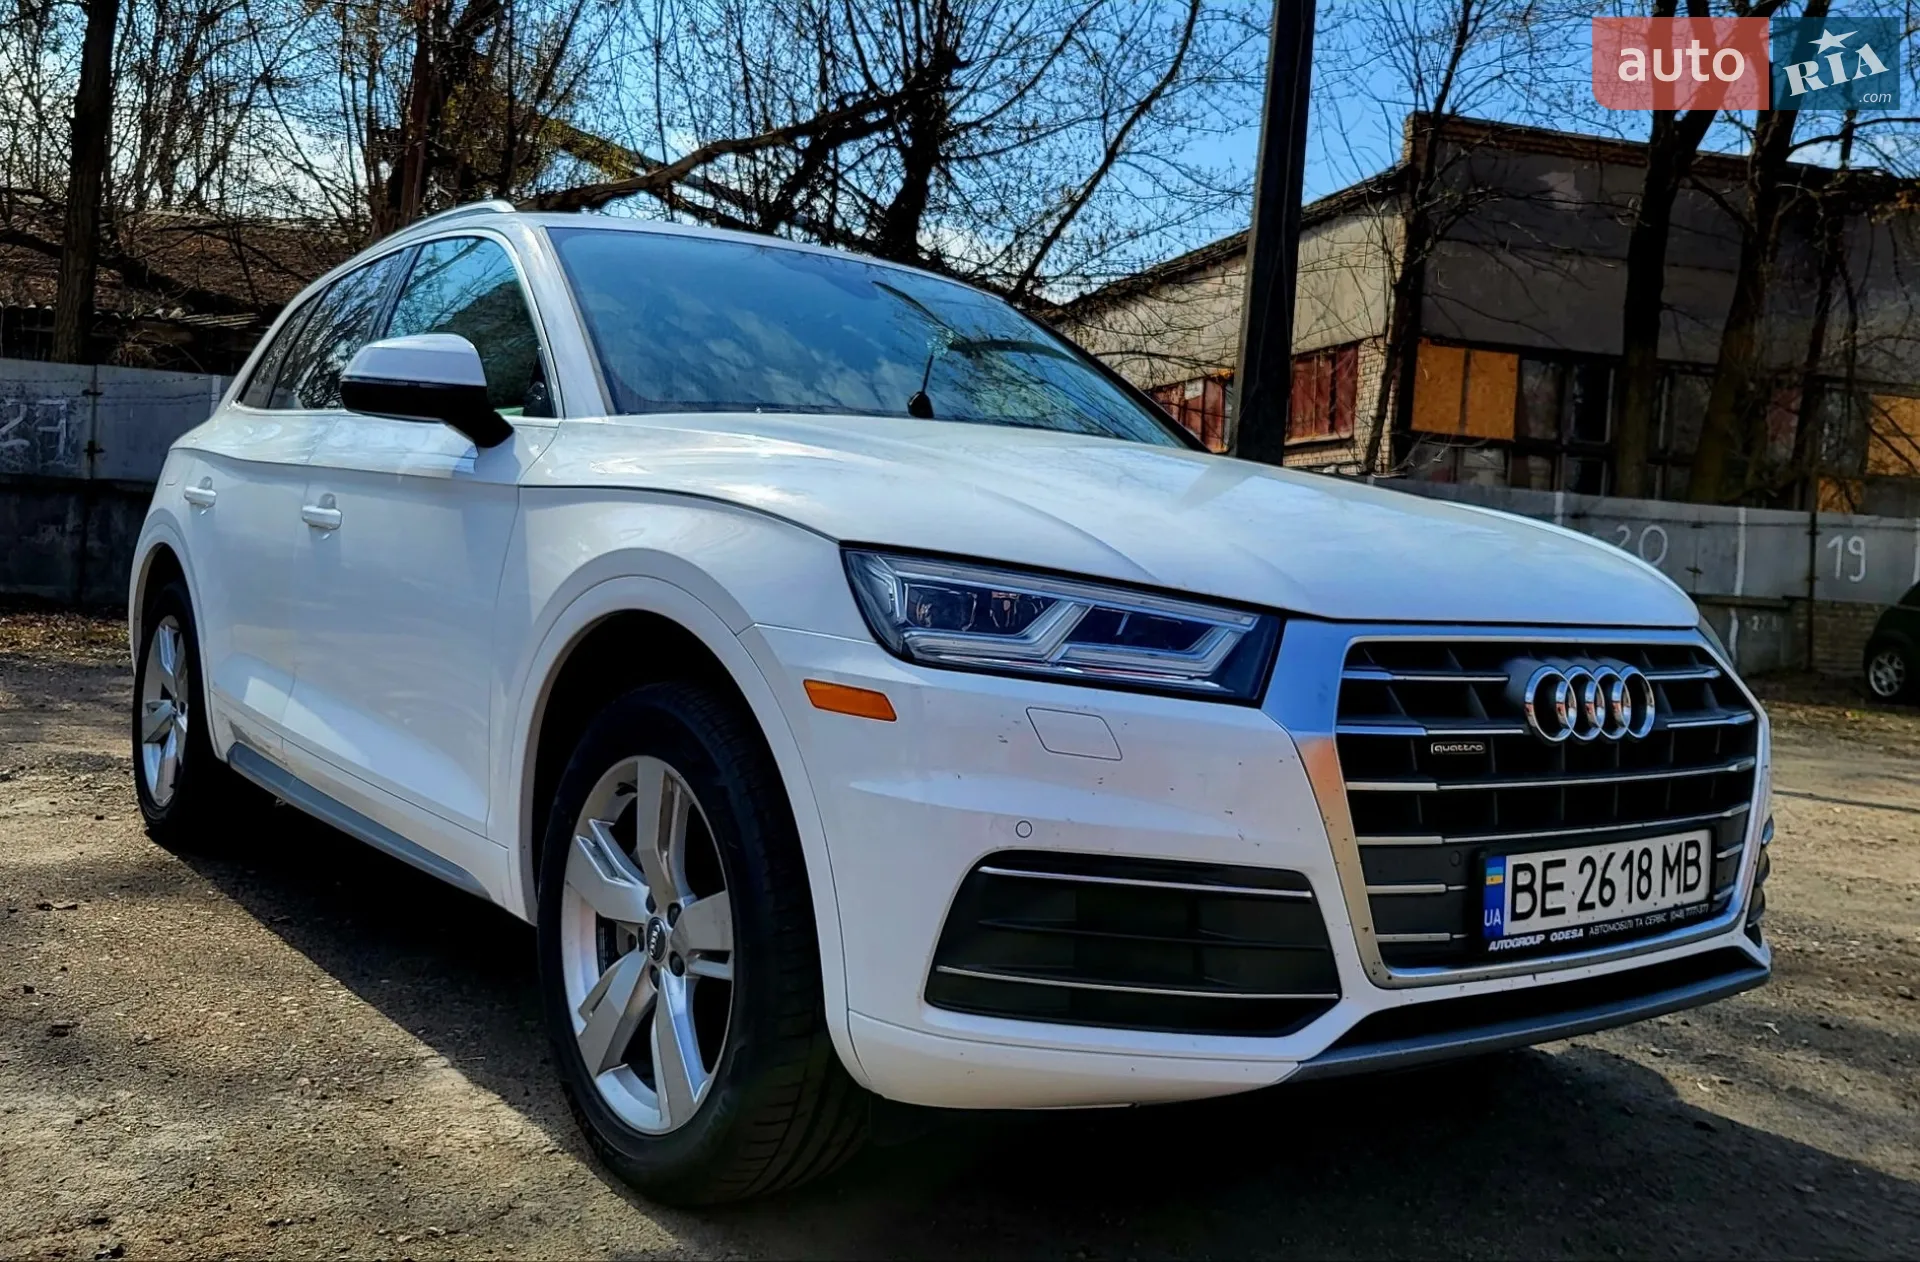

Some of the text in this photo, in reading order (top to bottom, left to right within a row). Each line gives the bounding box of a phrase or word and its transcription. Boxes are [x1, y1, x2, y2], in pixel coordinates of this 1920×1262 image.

[1826, 535, 1867, 582] 19
[1434, 744, 1484, 753] quattro
[1510, 839, 1701, 922] BE 2618 MB
[1484, 909, 1501, 926] UA
[1488, 928, 1584, 951] AUTOGROUP ODESA
